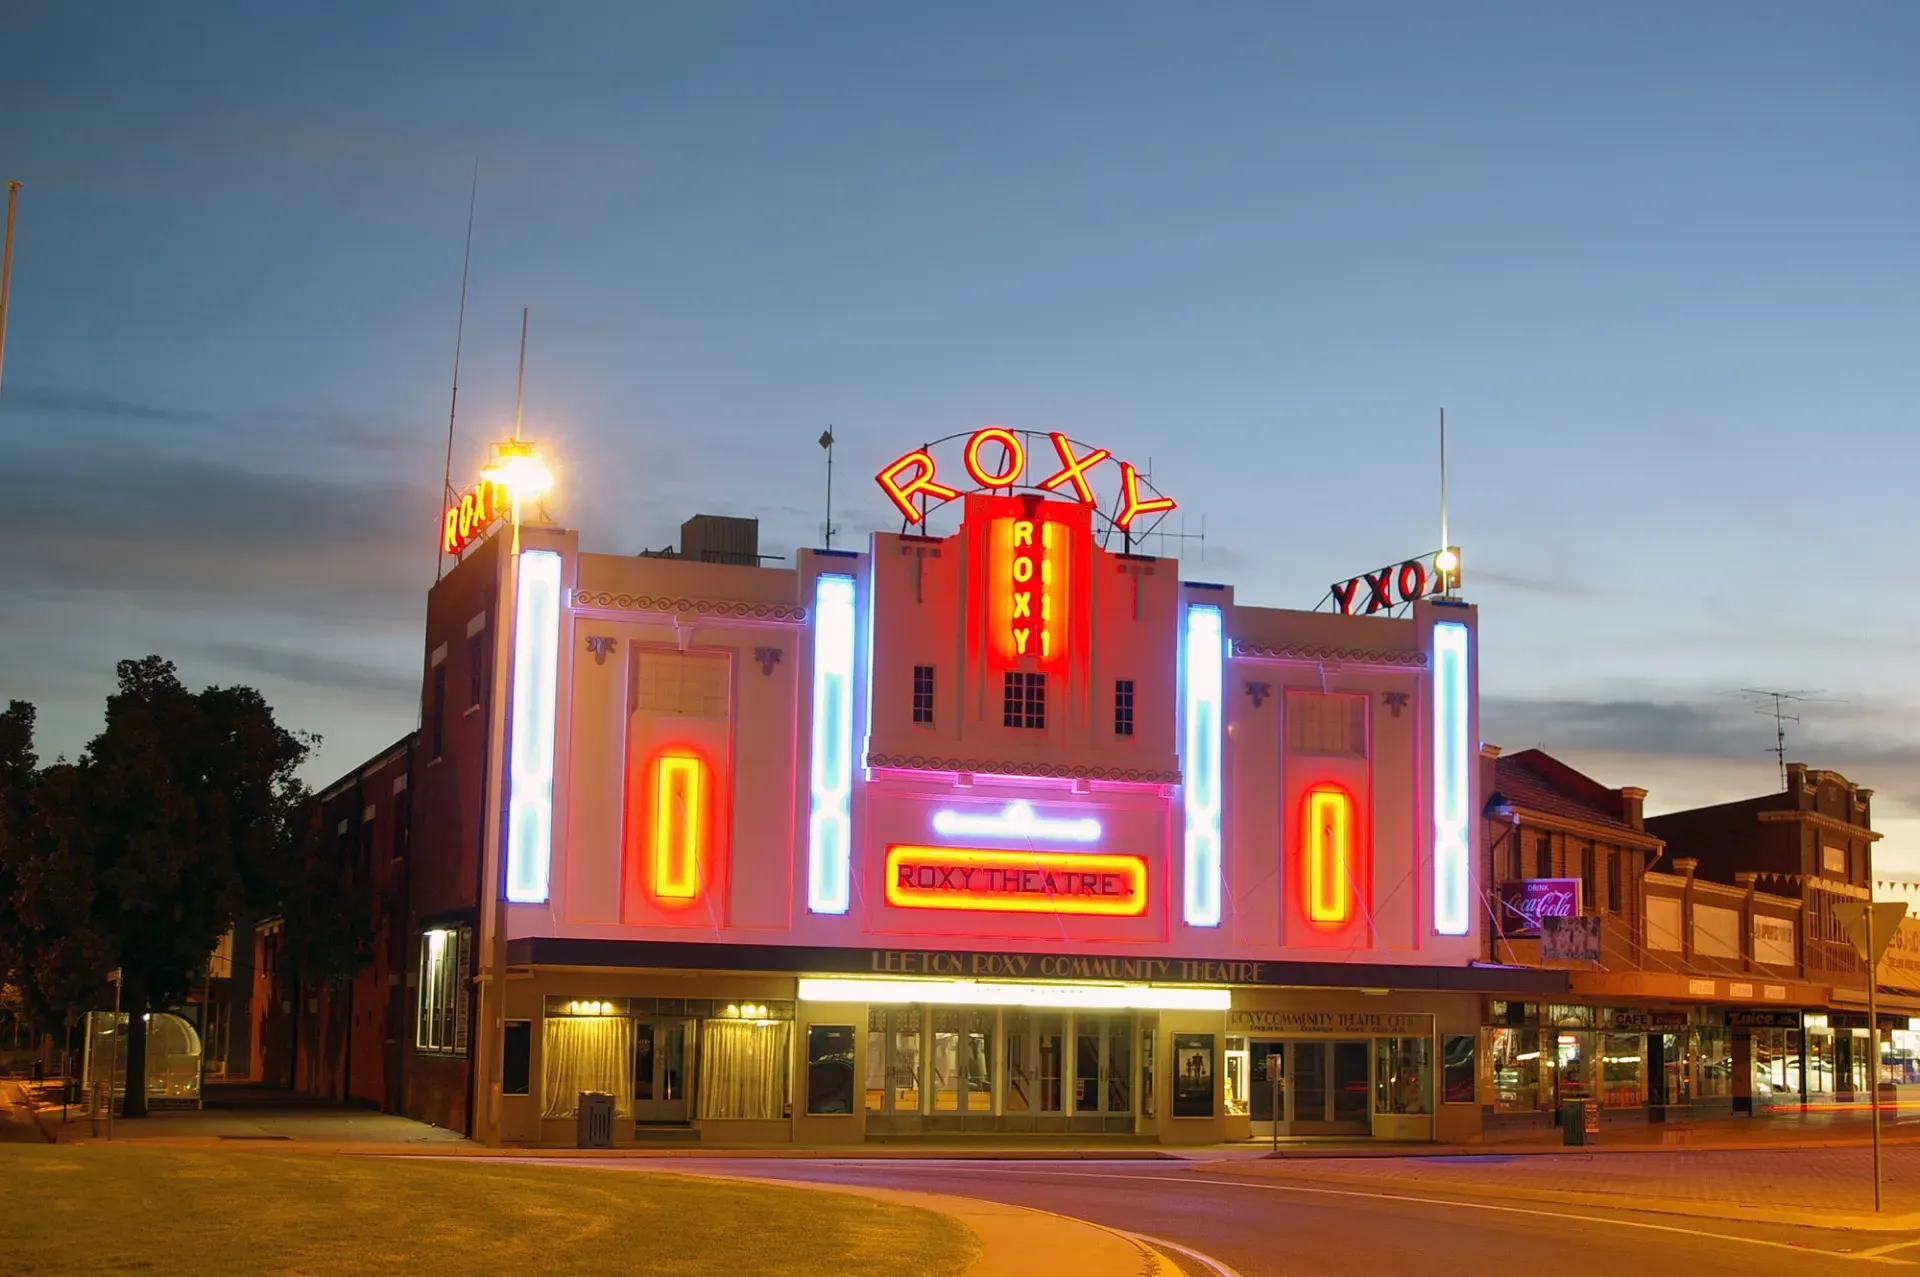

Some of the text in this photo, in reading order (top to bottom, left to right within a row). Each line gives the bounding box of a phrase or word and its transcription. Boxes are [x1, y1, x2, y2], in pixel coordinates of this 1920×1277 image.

[876, 428, 1177, 532] ROXY
[1013, 521, 1033, 654] ROXY
[896, 863, 1121, 897] ROXY THEATRE
[1528, 884, 1549, 892] DRINK
[872, 951, 1267, 982] LEETON ROXY COMMUNITY THEATRE
[1231, 1011, 1262, 1025] ROXY
[1264, 1012, 1333, 1026] COMMUNITY
[1339, 1013, 1382, 1027] THEATRE
[1616, 1014, 1648, 1025] CAFE
